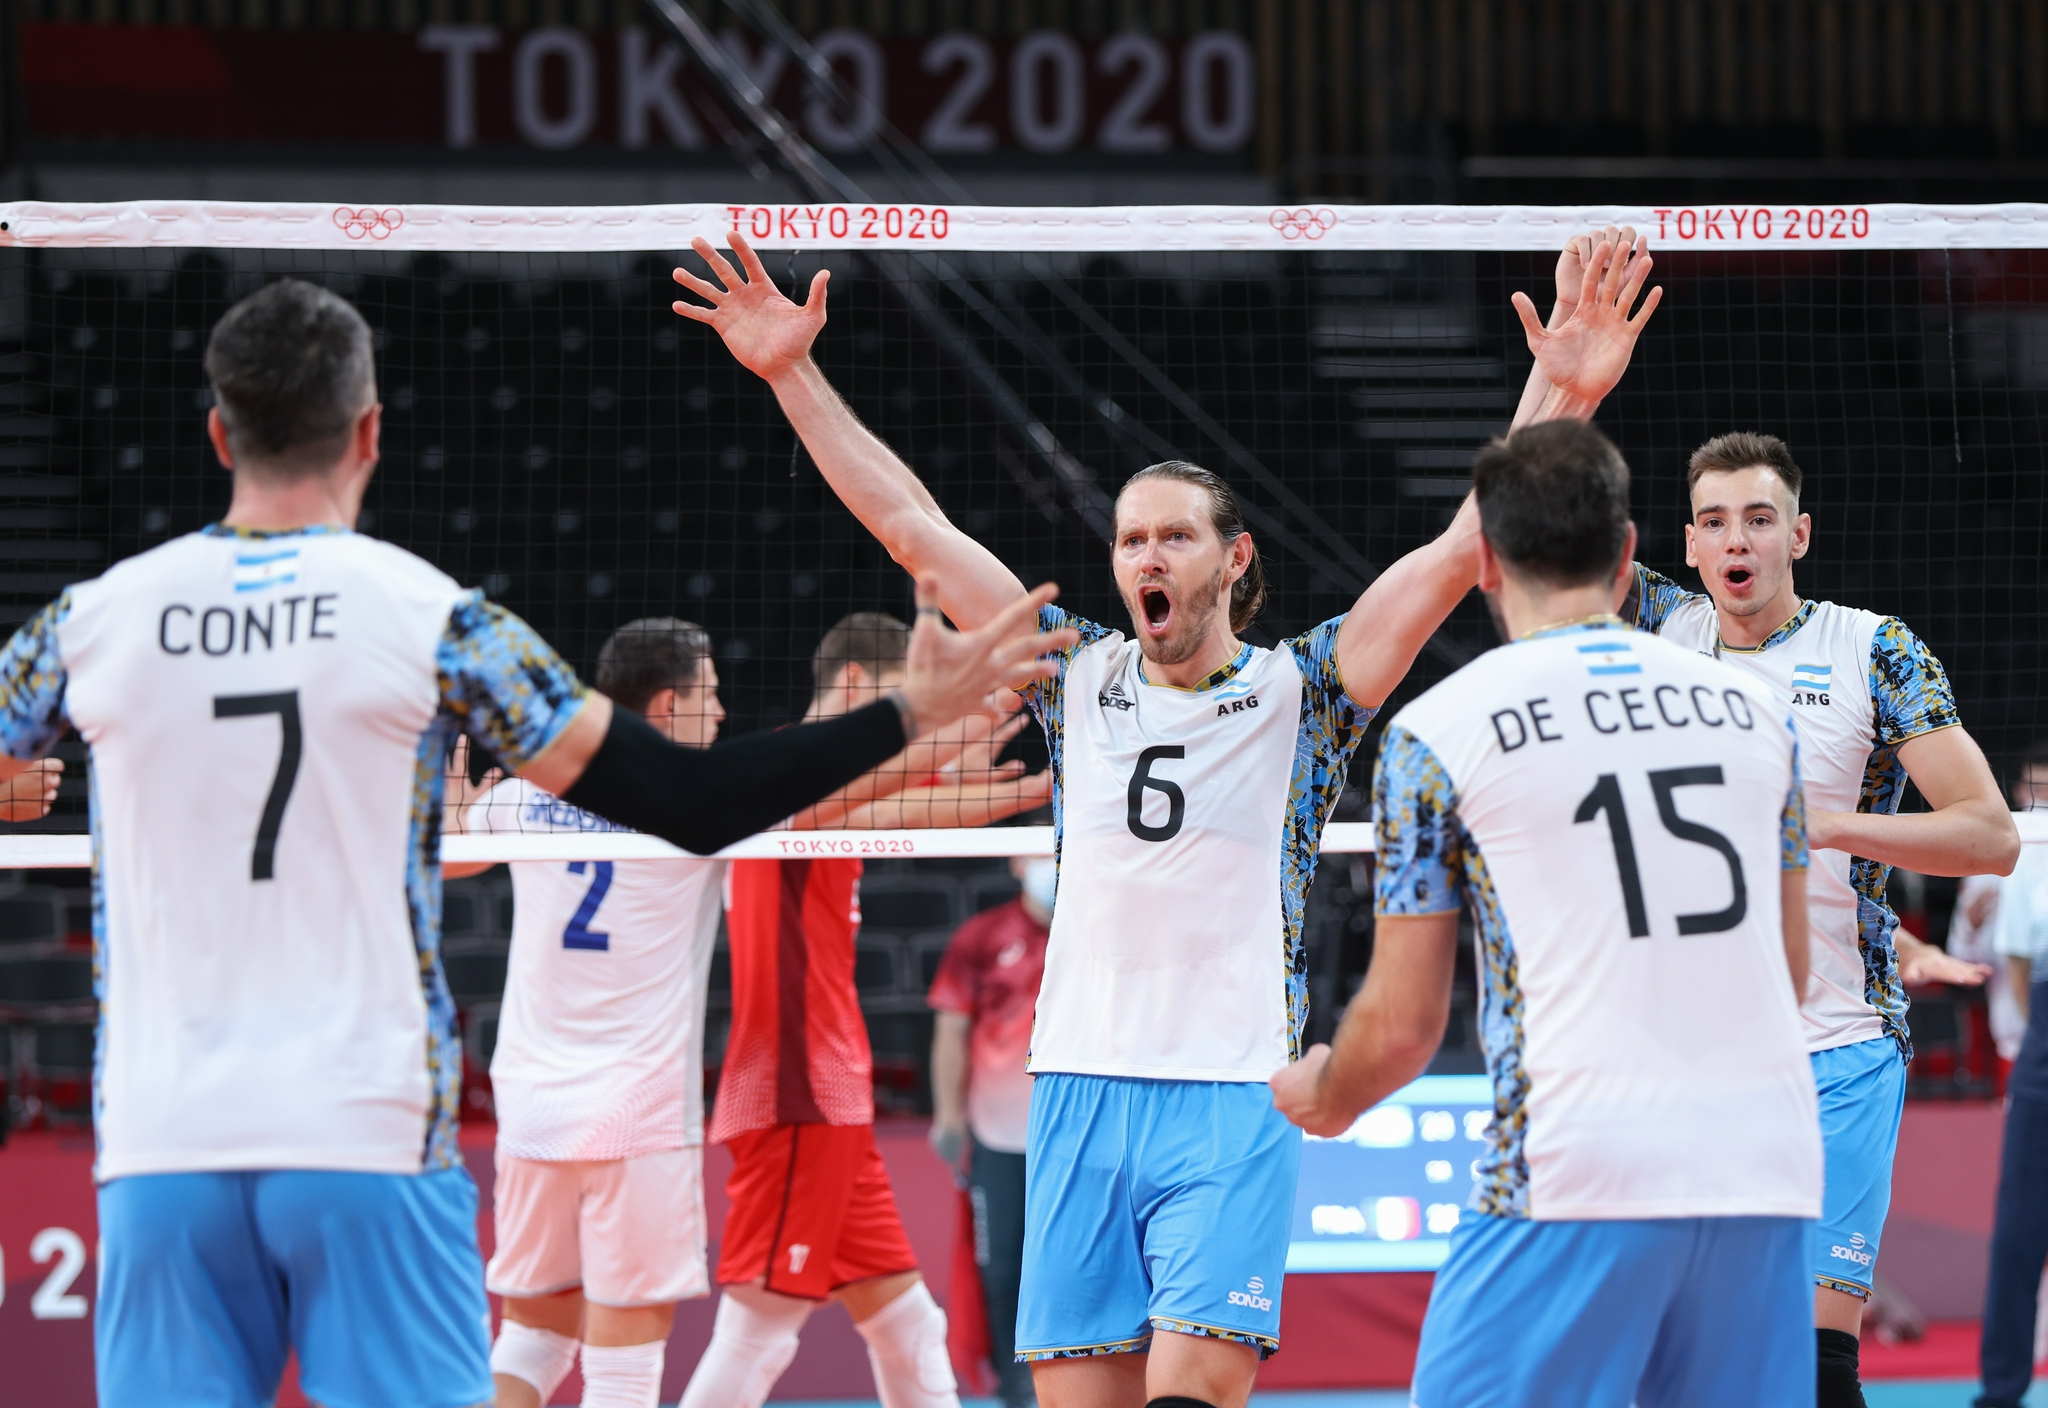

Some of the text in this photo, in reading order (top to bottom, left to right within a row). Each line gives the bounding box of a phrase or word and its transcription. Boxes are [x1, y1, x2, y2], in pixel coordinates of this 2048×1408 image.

[419, 25, 1256, 152] TOKYO 2020
[727, 207, 948, 239] TOKYO 2020
[1653, 208, 1869, 240] TOKYO 2020
[158, 593, 339, 656] CONTE
[1217, 695, 1259, 717] ARG
[1491, 684, 1755, 754] DE CECCO
[1791, 692, 1831, 706] ARG
[212, 688, 304, 882] 7
[1127, 744, 1186, 842] 6
[778, 838, 915, 854] TOKYO 2020
[1572, 764, 1748, 940] 15
[561, 861, 614, 952] 2
